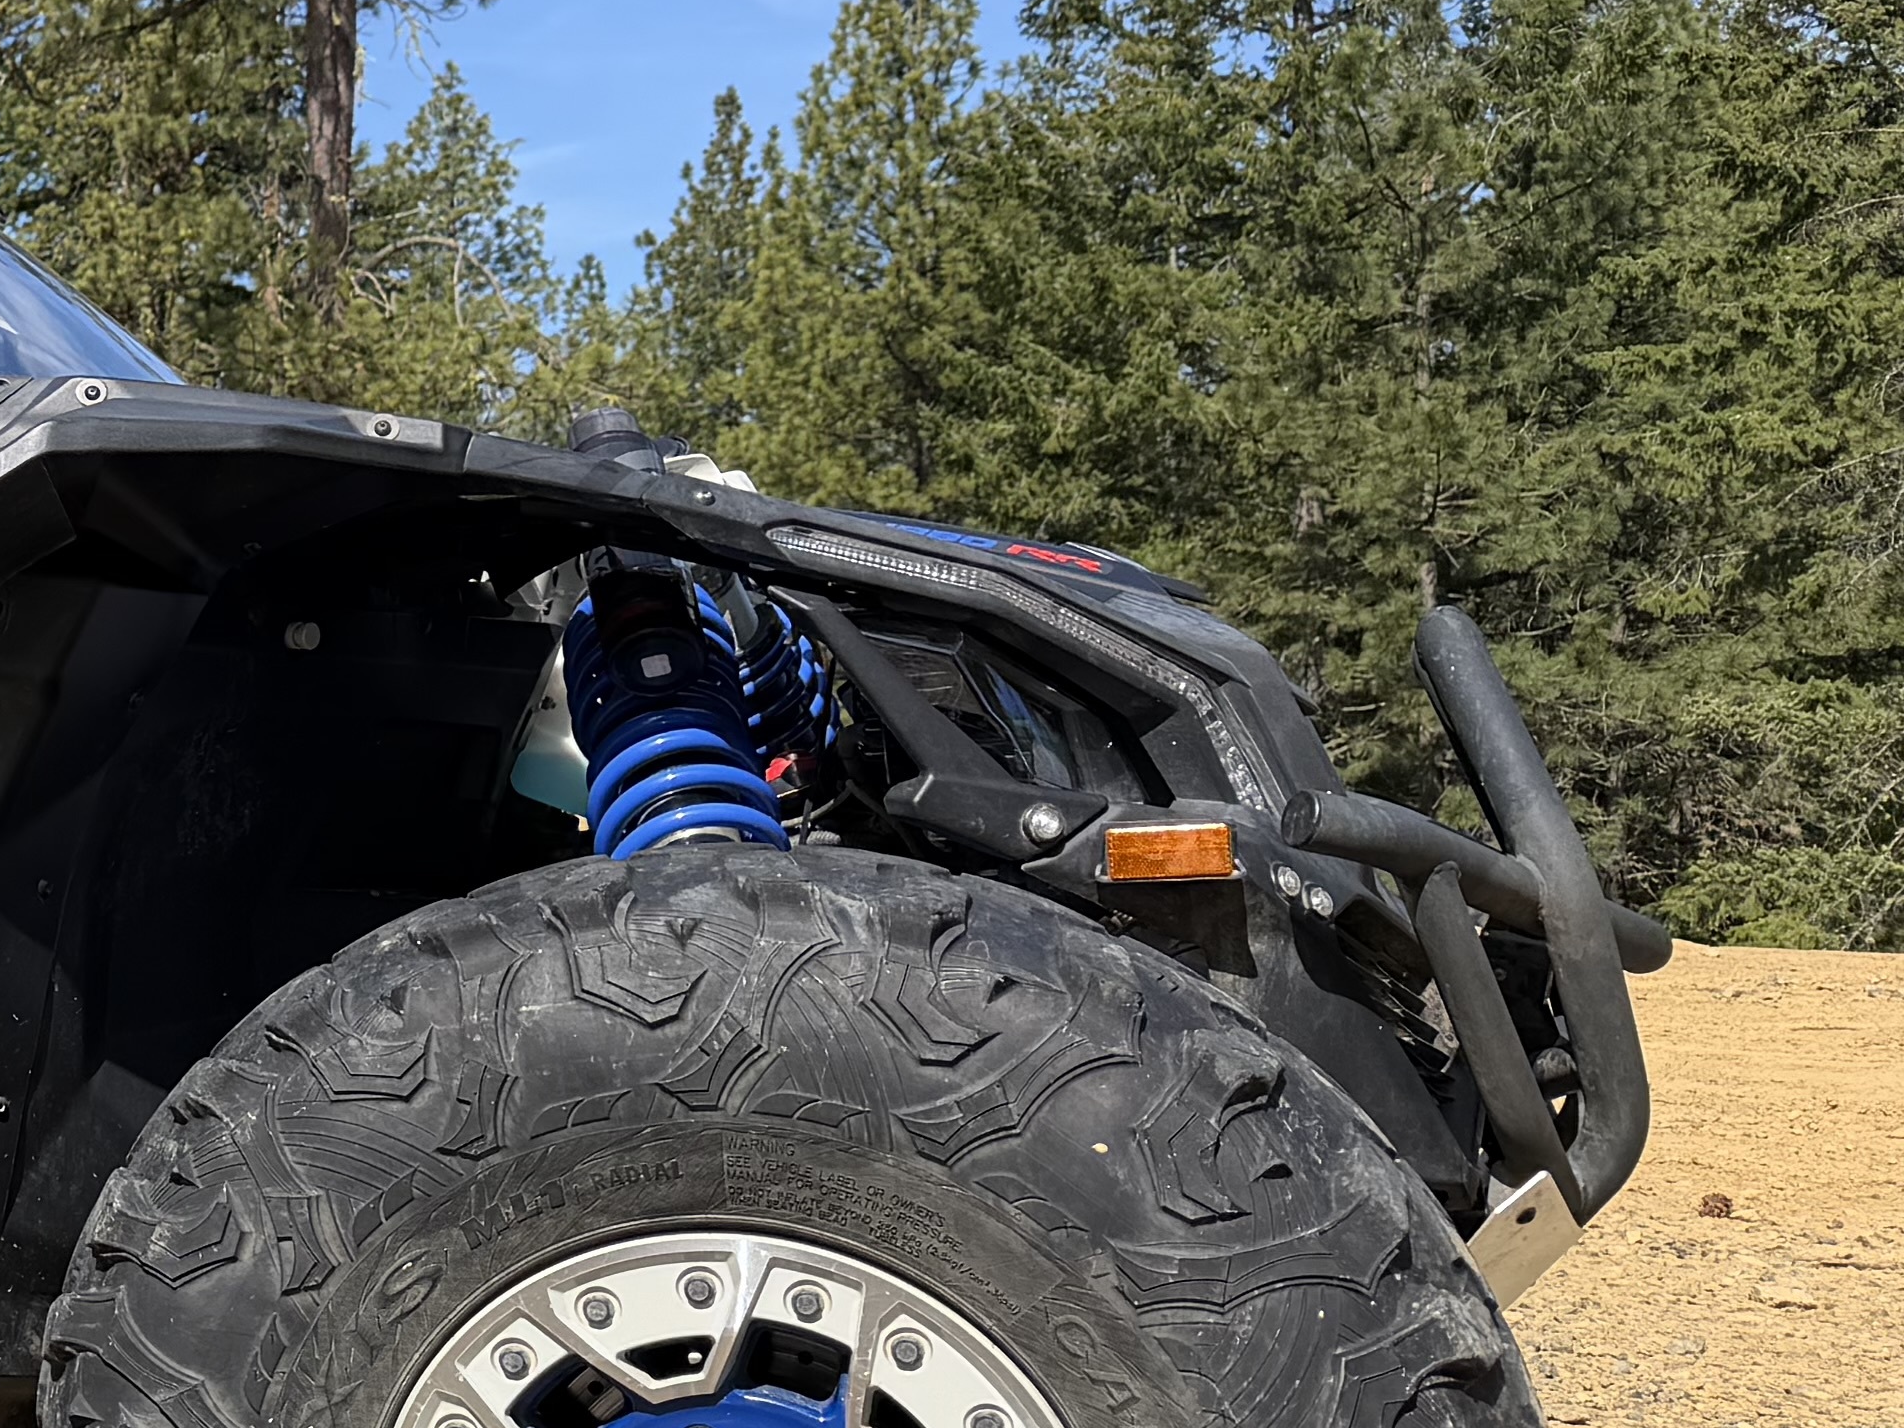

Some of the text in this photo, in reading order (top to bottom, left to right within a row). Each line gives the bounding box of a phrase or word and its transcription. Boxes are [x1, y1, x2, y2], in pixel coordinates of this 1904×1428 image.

[728, 1137, 795, 1156] WARNING
[590, 1160, 685, 1191] RADIAL
[726, 1156, 751, 1169] SEE
[761, 1159, 813, 1178] VEHICLE
[819, 1171, 859, 1192] LABEL
[867, 1185, 884, 1199] OR
[787, 1177, 813, 1190] FOR
[820, 1186, 892, 1217] OPERATING
